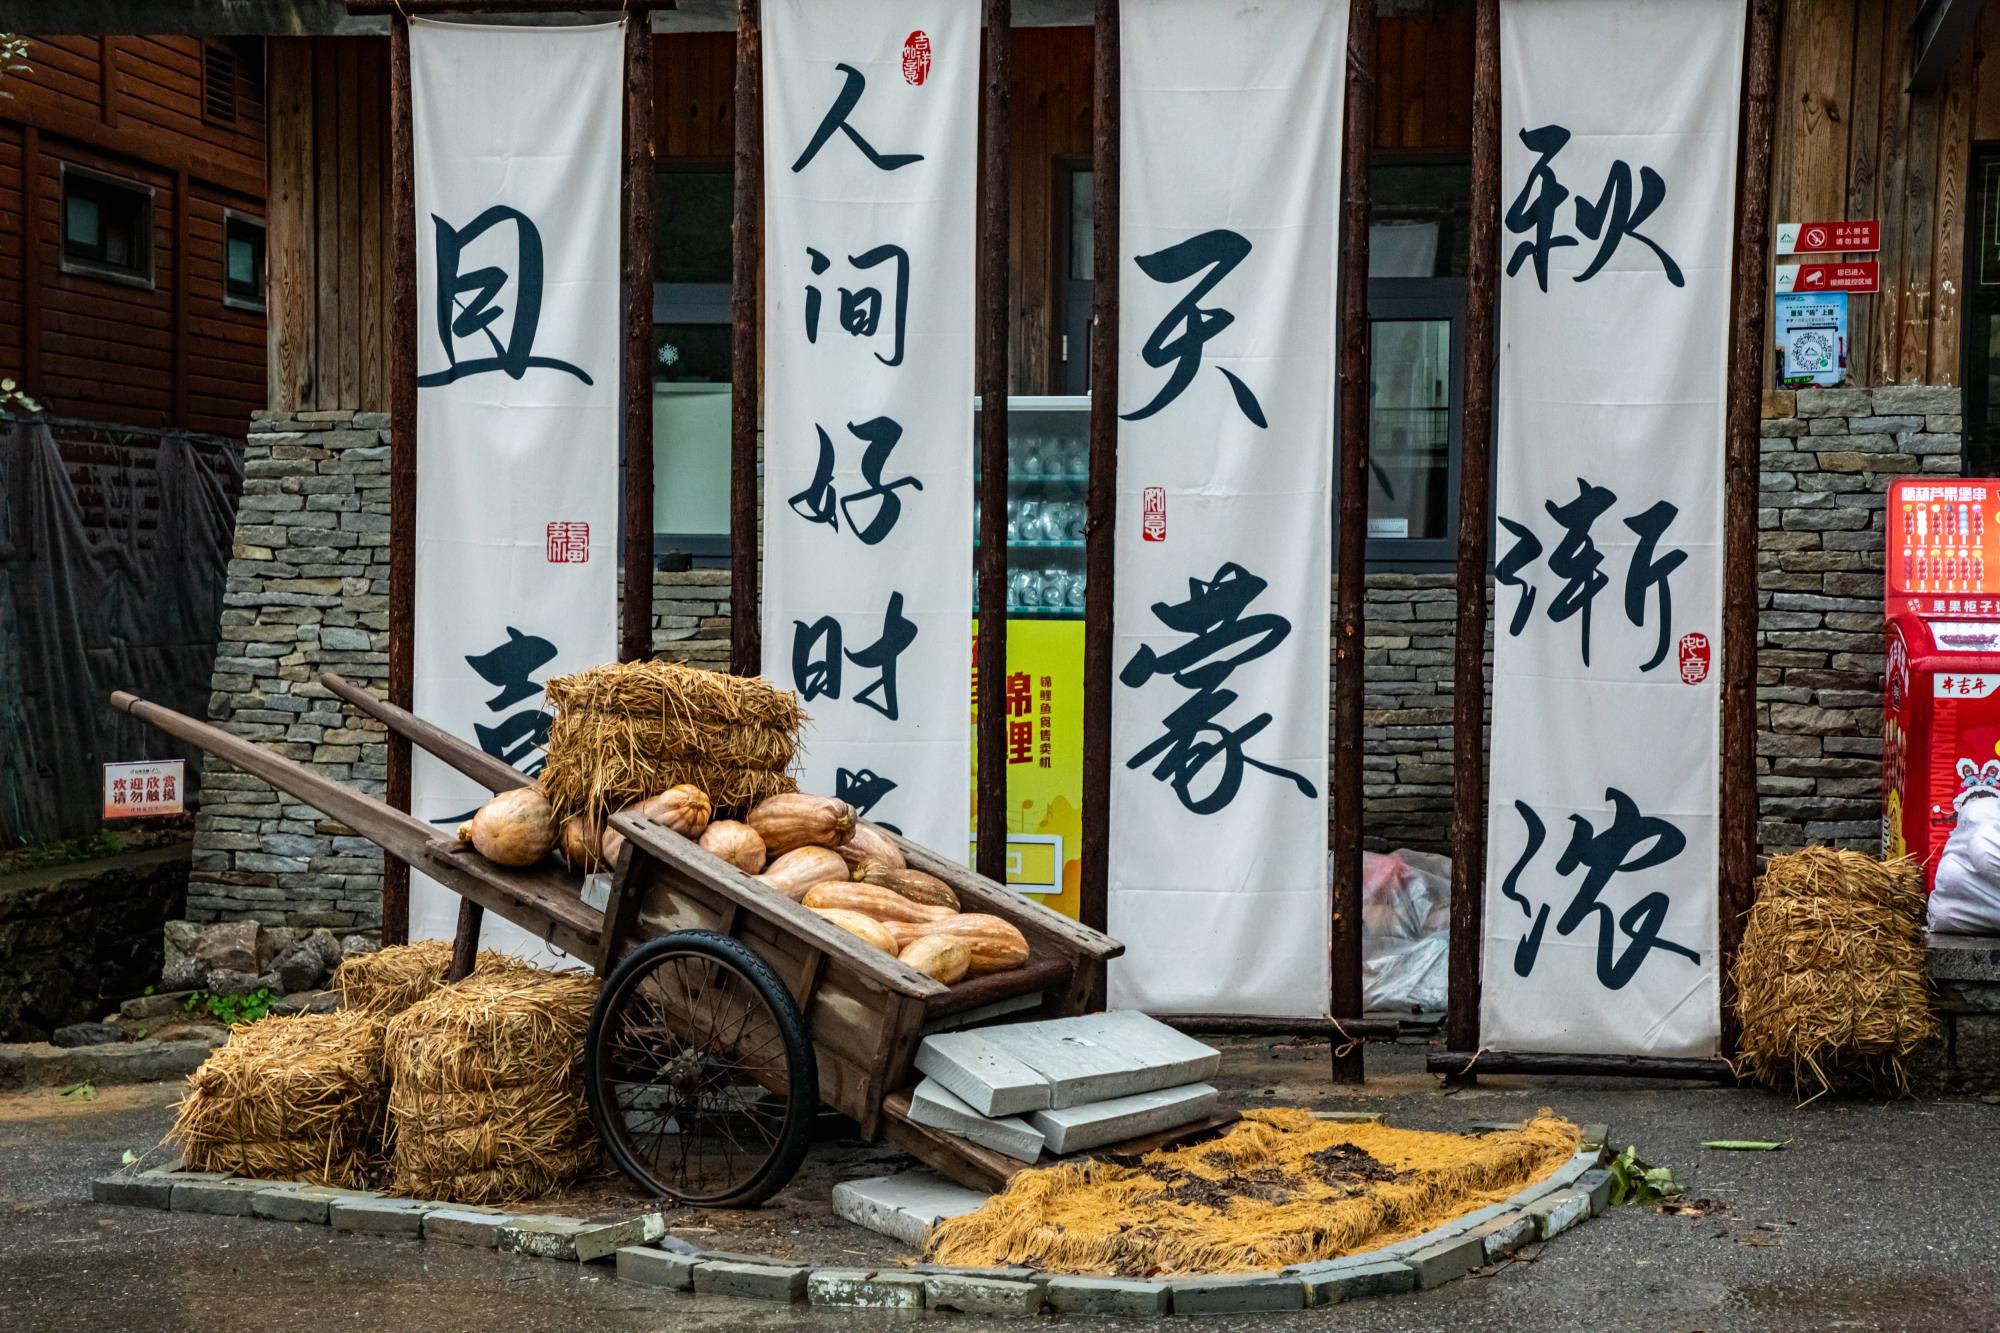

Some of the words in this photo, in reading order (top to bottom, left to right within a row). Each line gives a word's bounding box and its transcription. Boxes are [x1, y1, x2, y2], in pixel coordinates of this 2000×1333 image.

[1836, 227, 1870, 235] 进入景区
[1837, 268, 1866, 276] 您已进入
[1495, 125, 1701, 990] 秋渐浓
[1038, 675, 1053, 769] 锦鲤鱼食售卖机
[113, 775, 176, 791] 欢迎欣赏
[113, 788, 176, 804] 请勿触摸
